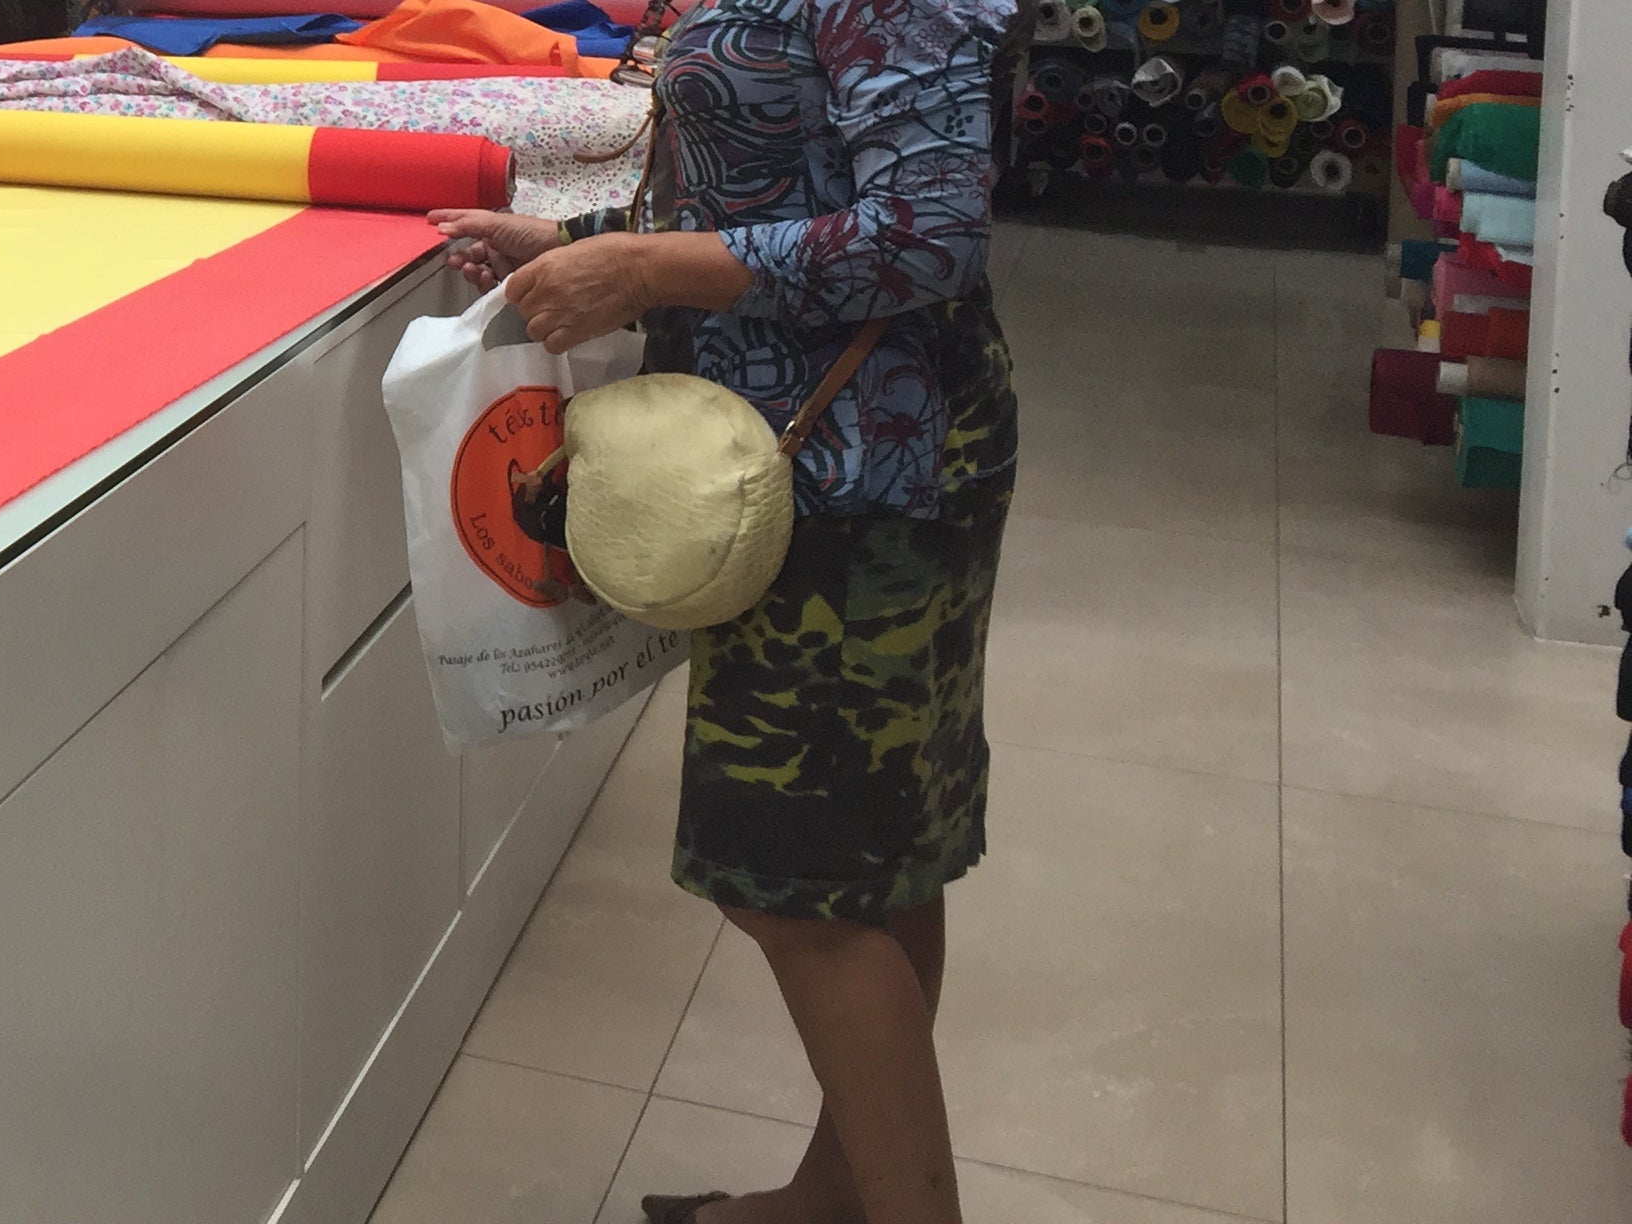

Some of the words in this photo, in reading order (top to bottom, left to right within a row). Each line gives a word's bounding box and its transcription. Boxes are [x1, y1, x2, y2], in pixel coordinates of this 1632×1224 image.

[470, 512, 496, 551] Los
[477, 648, 490, 663] de
[497, 687, 583, 733] pasión
[584, 660, 629, 700] por
[635, 634, 656, 669] el
